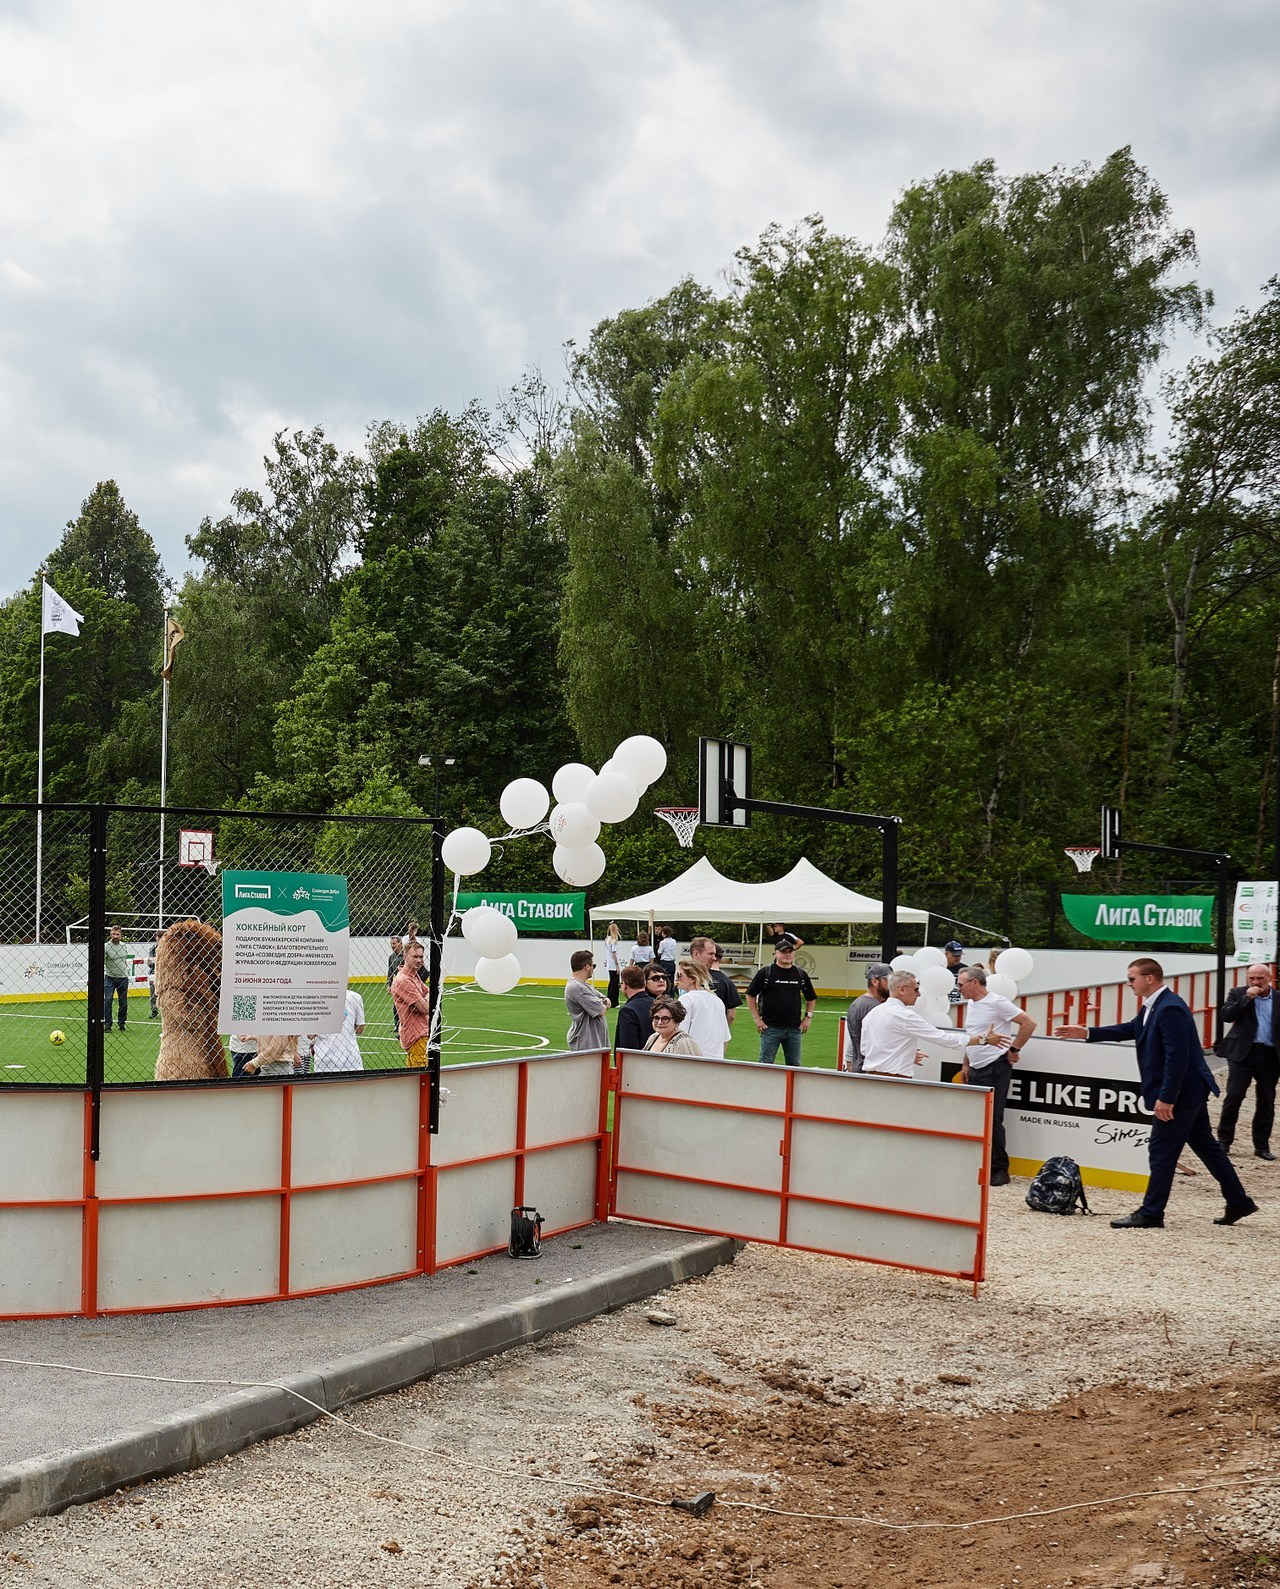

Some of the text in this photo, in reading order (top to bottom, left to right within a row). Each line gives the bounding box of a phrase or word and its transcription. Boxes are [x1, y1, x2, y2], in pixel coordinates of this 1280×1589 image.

[236, 922, 306, 933] ХОККЕЙНЫЙ КОРТ
[849, 951, 882, 959] Вмест
[1006, 1079, 1022, 1101] E
[1029, 1081, 1091, 1109] LIKE
[1020, 1115, 1042, 1124] MADE
[1053, 1119, 1080, 1129] RUSSIA
